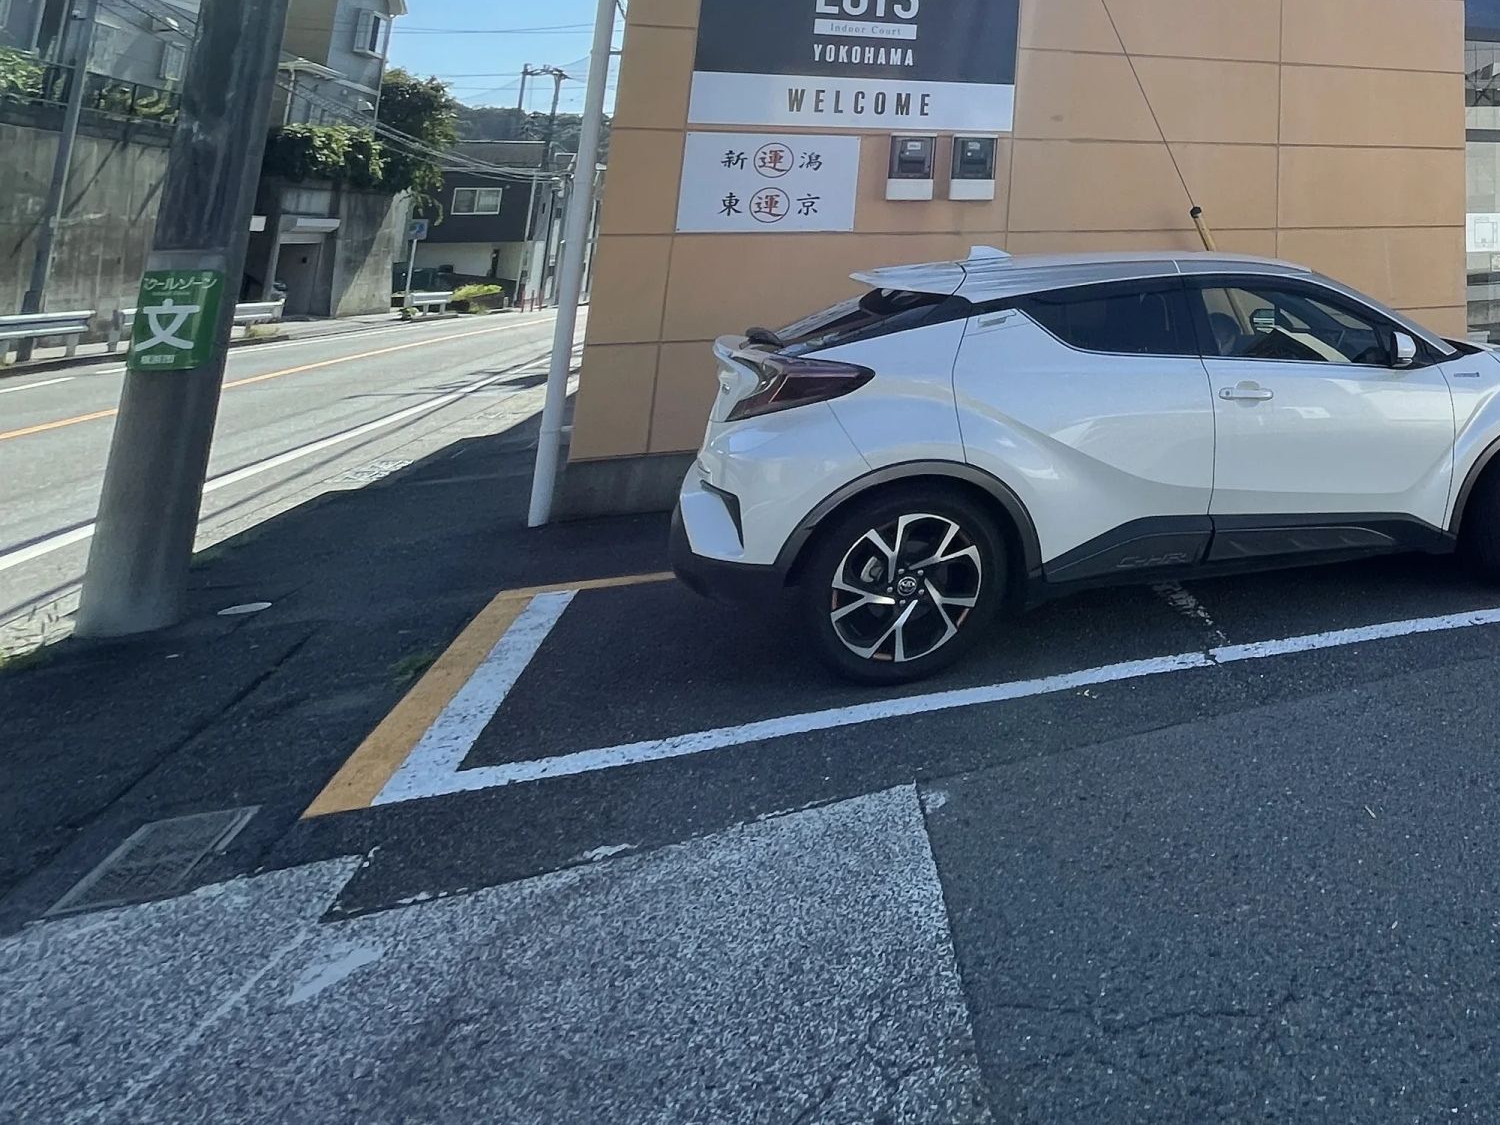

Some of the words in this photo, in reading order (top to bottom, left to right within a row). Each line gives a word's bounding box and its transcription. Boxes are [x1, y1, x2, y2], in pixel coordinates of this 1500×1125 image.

[830, 22, 866, 34] Indoor
[871, 25, 902, 36] Court
[813, 43, 914, 66] YOKOHAMA
[788, 88, 931, 116] WELCOME
[135, 298, 200, 352] 文
